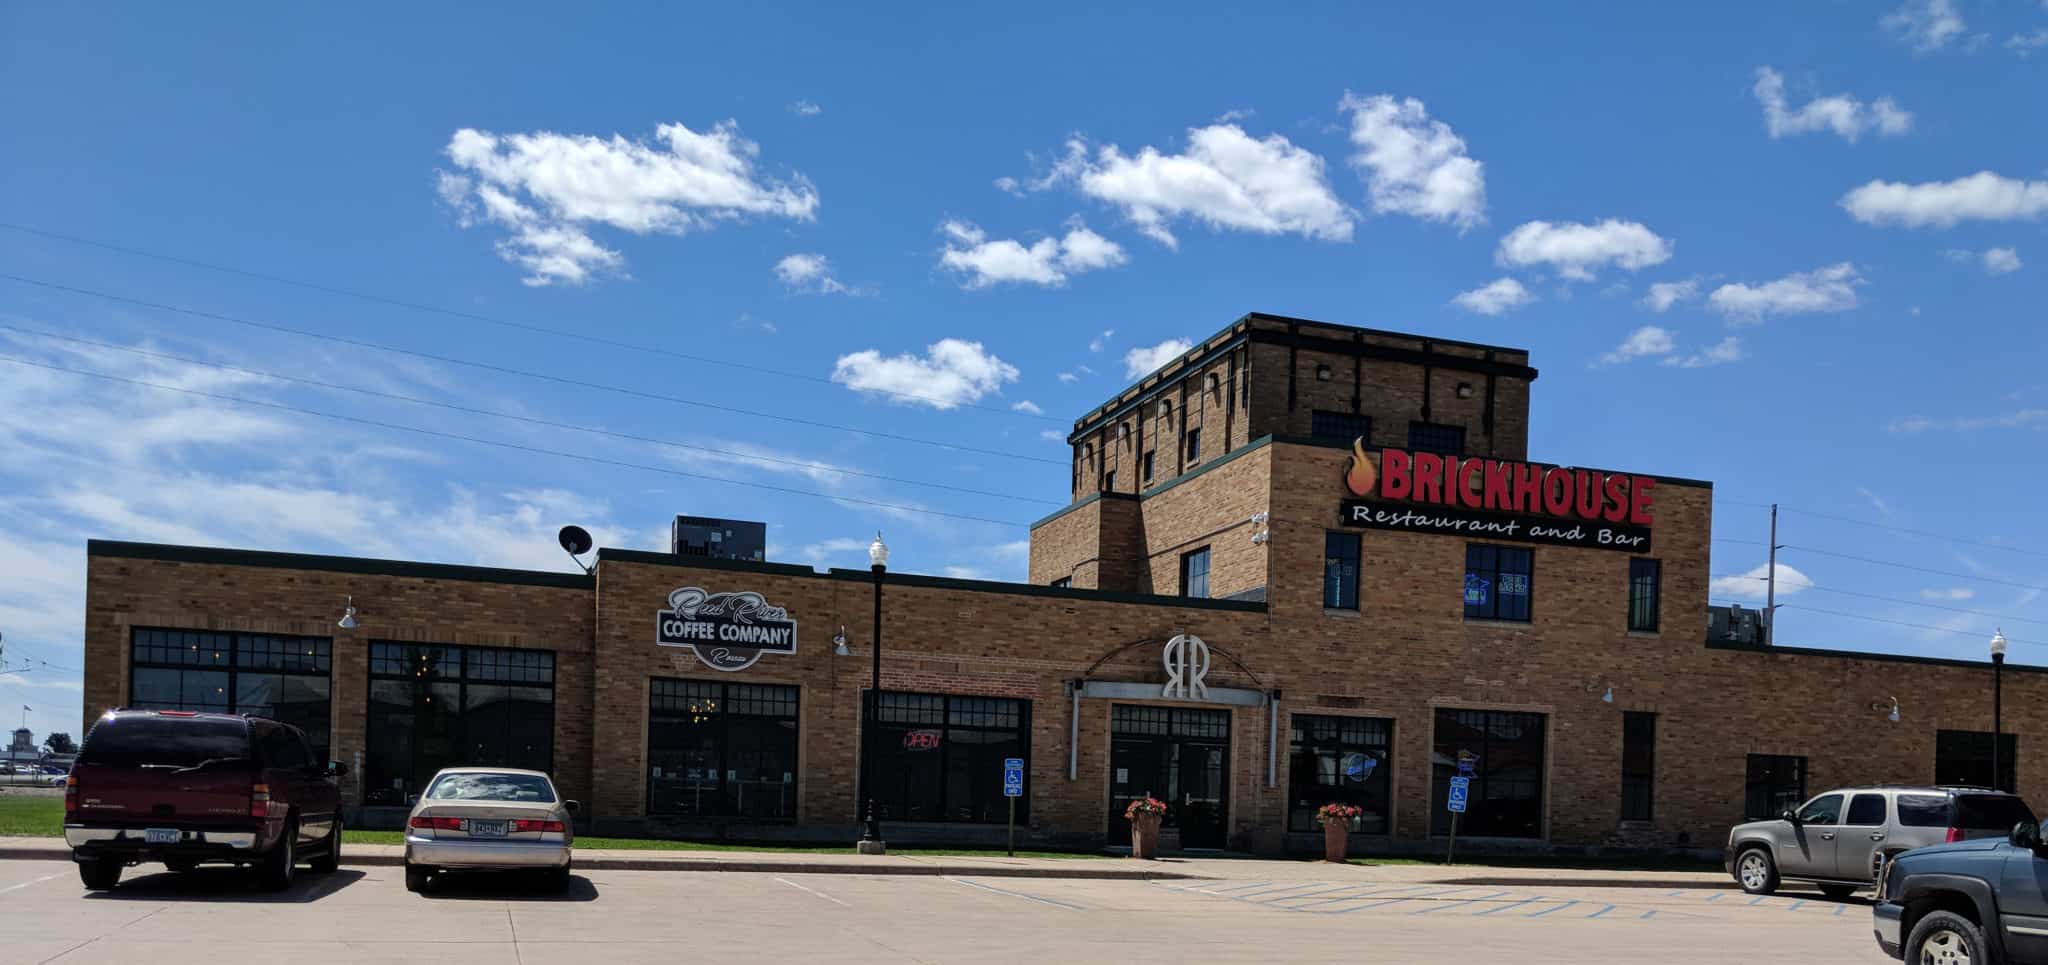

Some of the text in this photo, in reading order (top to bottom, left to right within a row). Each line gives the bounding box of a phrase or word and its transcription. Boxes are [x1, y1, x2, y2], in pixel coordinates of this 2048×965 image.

[1381, 448, 1656, 524] BRICKHOUSE
[1352, 505, 1645, 547] Restaurant and Bar
[730, 593, 786, 624] River
[663, 620, 791, 645] COFFEE COMPANY
[904, 732, 940, 749] OPEN
